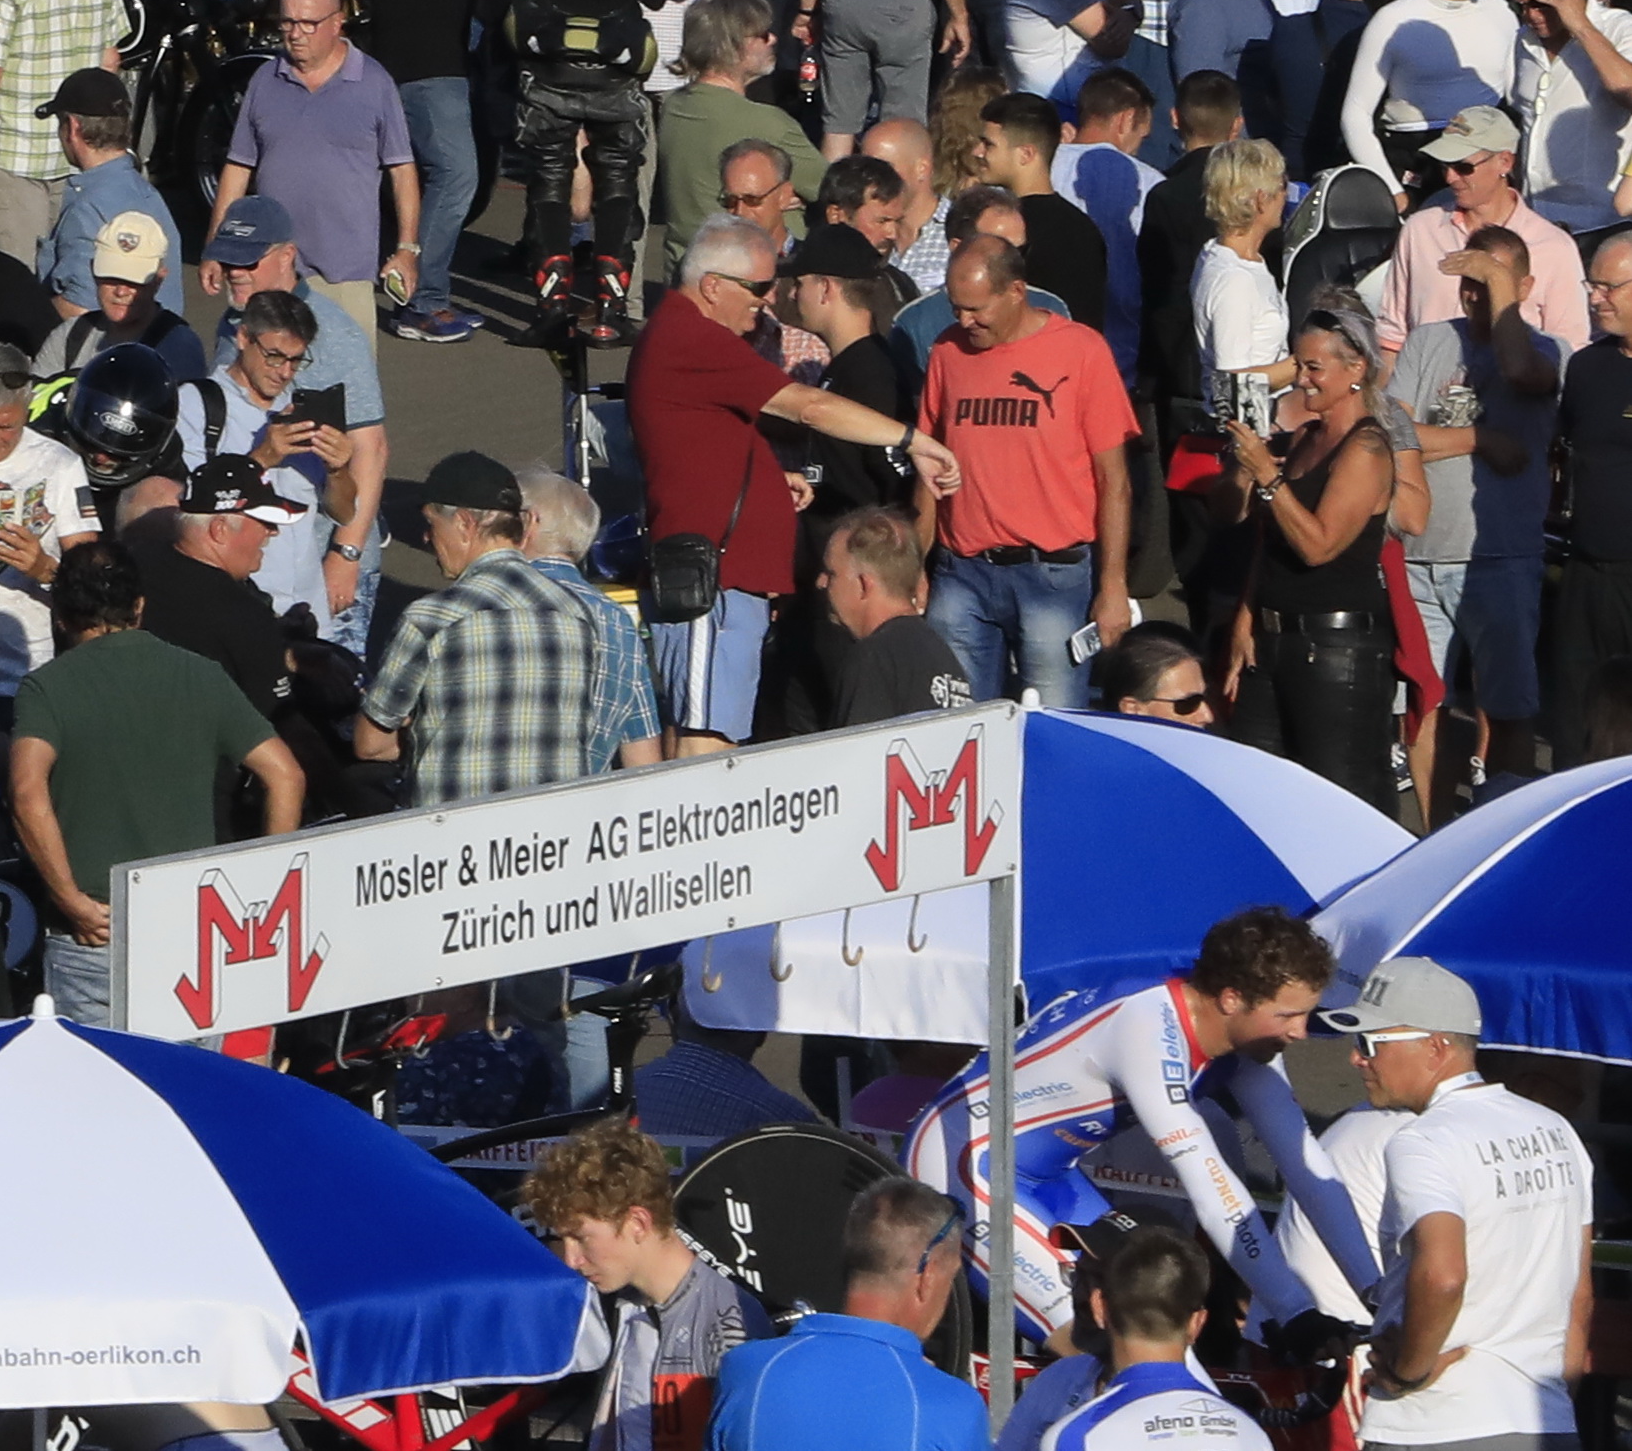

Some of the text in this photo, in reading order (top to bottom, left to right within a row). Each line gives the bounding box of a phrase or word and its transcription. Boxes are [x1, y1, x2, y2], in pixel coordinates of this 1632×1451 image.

[955, 398, 1039, 427] PUMA
[355, 783, 839, 908] Mösler & Meier AG Elektroanlagen
[442, 864, 752, 955] Zürich und Wallisellen
[1013, 1080, 1073, 1105] lectric
[1476, 1139, 1504, 1166] LA
[1013, 1250, 1058, 1294] lectric
[1143, 1414, 1238, 1434] afeno GmbH
